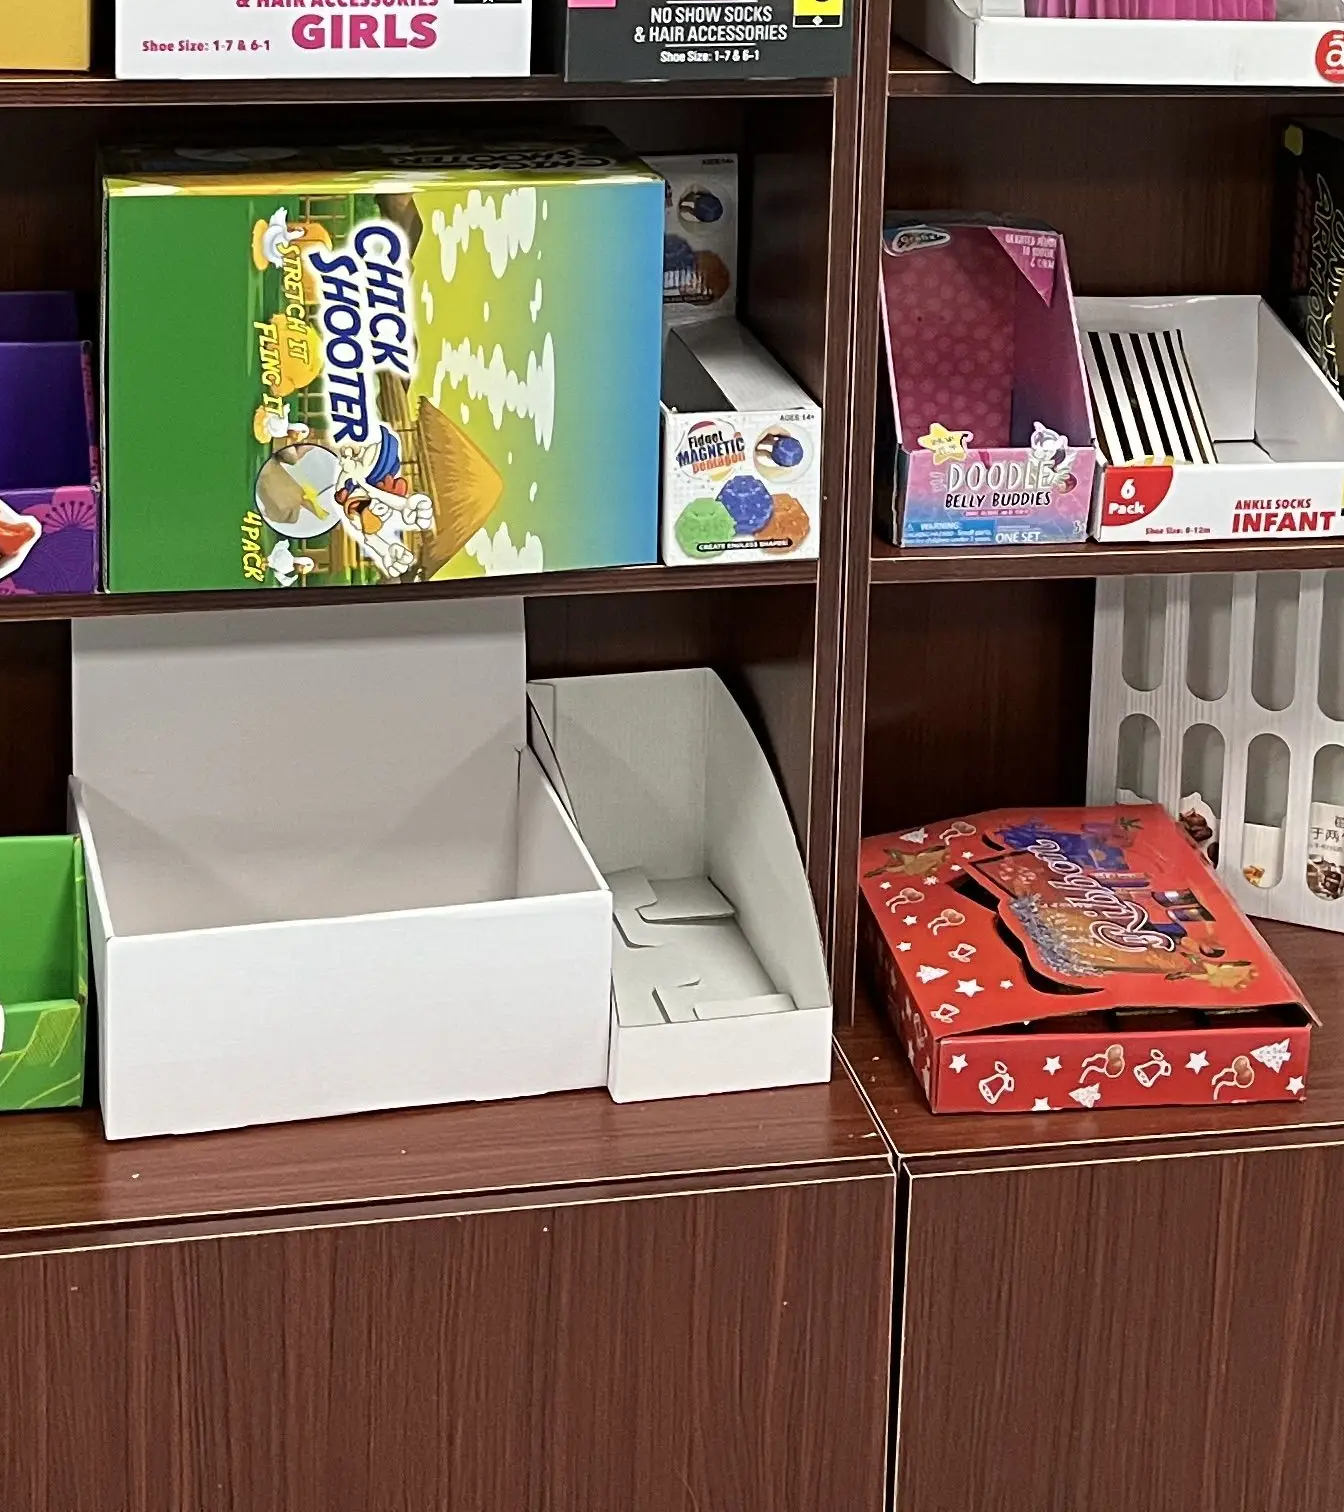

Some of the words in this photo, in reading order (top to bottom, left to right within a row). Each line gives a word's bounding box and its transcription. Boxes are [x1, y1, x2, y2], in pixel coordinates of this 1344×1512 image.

[650, 6, 673, 24] NO
[675, 6, 722, 24] SHOW
[724, 5, 773, 23] SOCKS
[291, 13, 439, 50] GIRLS
[634, 26, 646, 43] &
[649, 26, 685, 43] HAIR
[687, 24, 788, 42] ACCESSORIES
[142, 39, 175, 52] Shoe
[177, 39, 209, 52] Size:
[660, 50, 685, 63] Shoe
[687, 49, 713, 63] Size:
[277, 243, 308, 330] STRETCH
[353, 224, 410, 375] CHICK
[254, 320, 282, 391] FLING
[289, 331, 309, 364] IT
[308, 250, 370, 445] SHOOTER
[262, 392, 284, 419] IT
[676, 437, 745, 468] MAGNETIC
[948, 461, 1055, 493] DOODLE
[1119, 478, 1136, 500] 6
[944, 493, 987, 509] BELLY
[992, 491, 1052, 507] BUDDIES
[1107, 501, 1146, 516] Pack
[1234, 499, 1273, 511] ANKLE
[1275, 498, 1312, 510] SOCKS
[1231, 511, 1337, 534] INFANT
[995, 532, 1018, 543] ONE
[1020, 531, 1042, 542] SET
[1025, 838, 1177, 953] Ribbon
